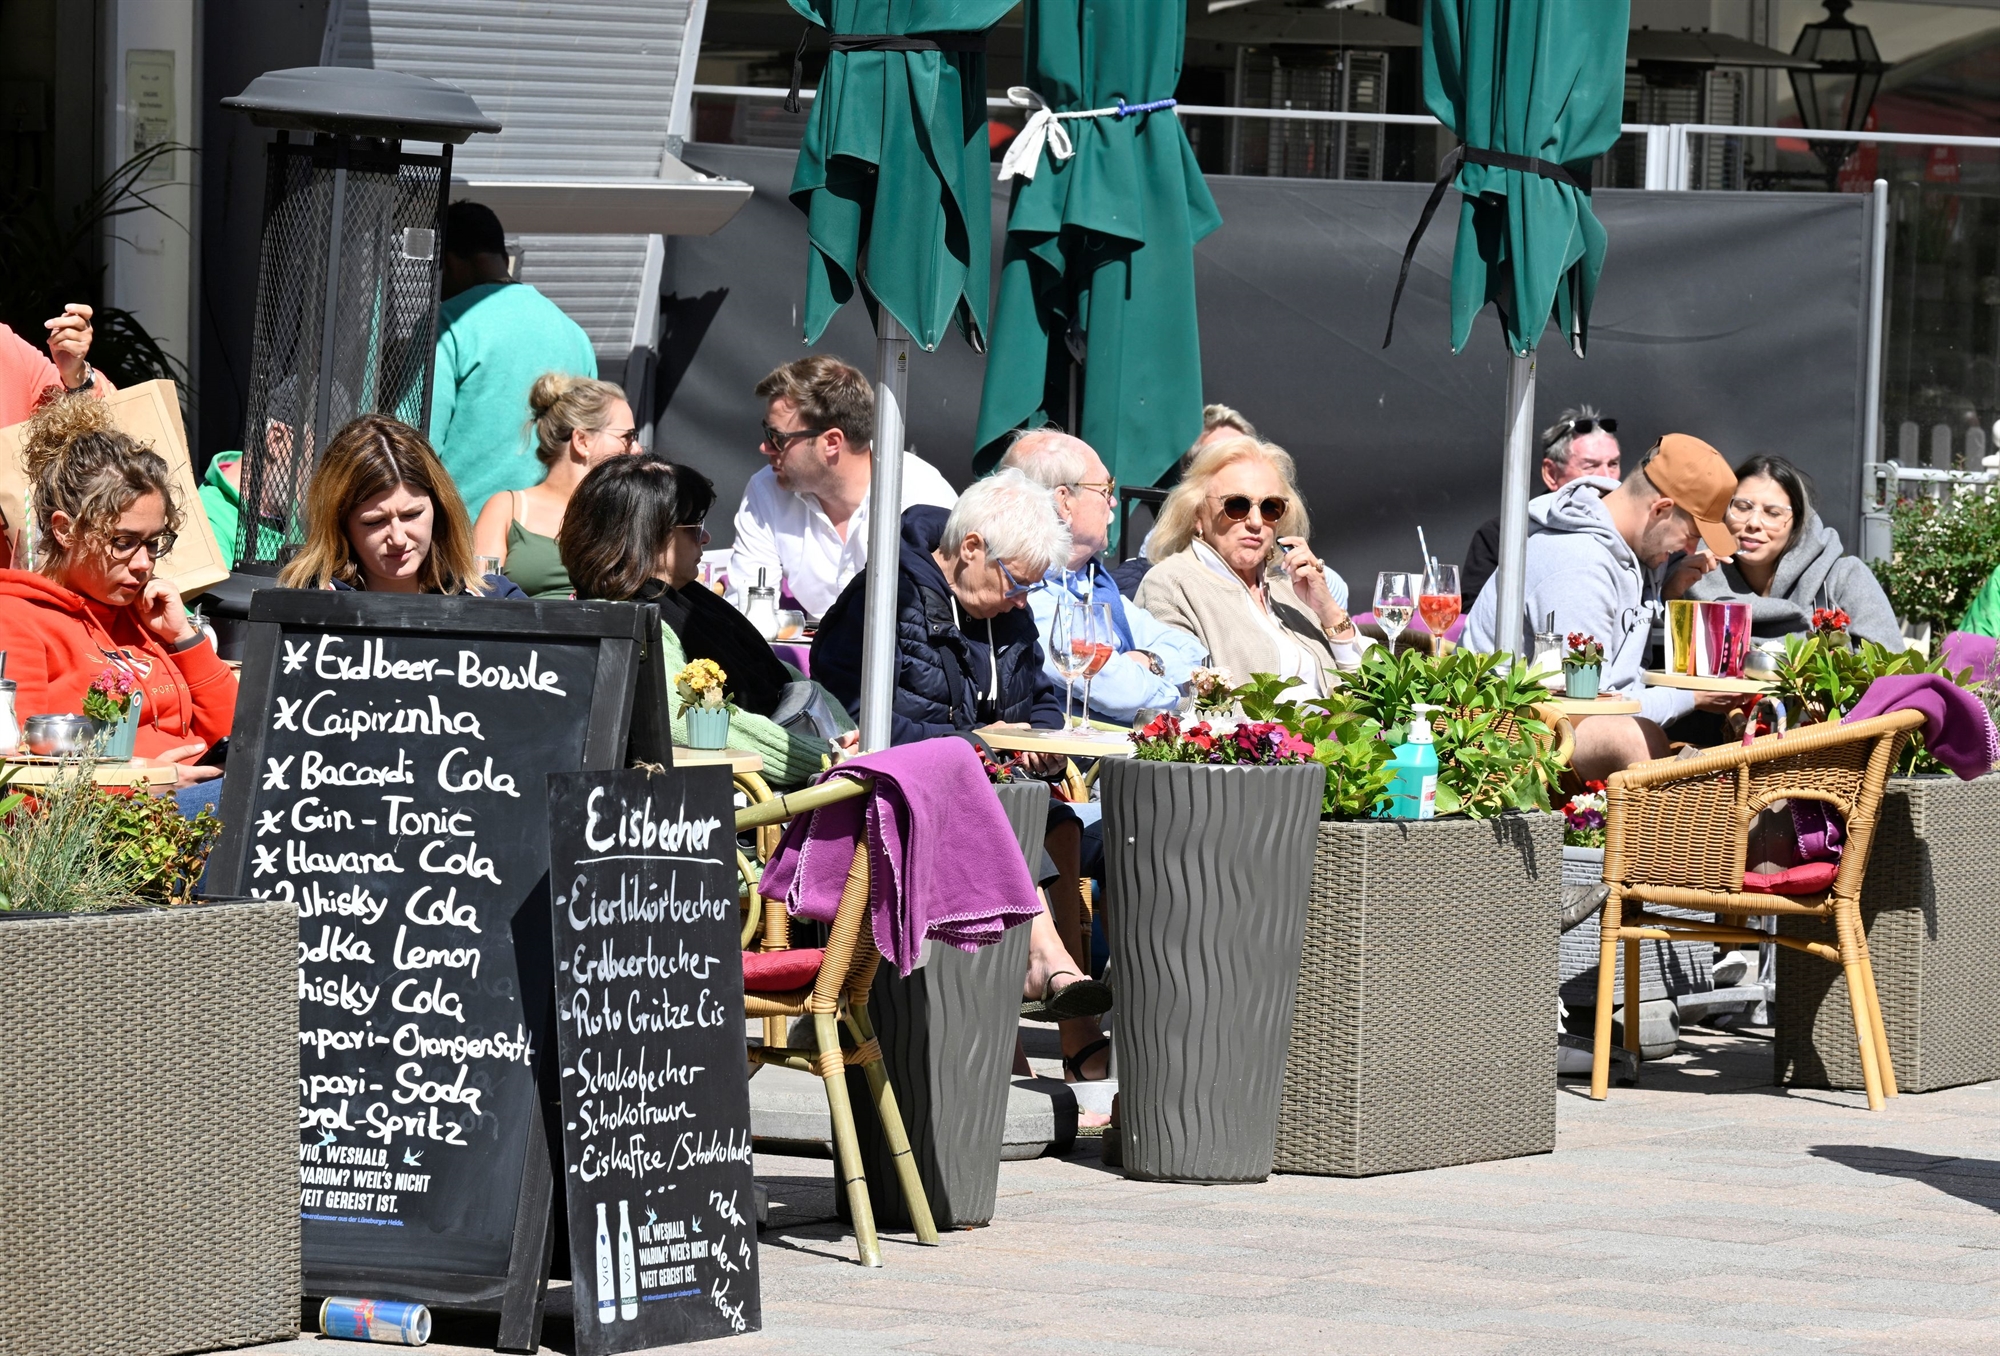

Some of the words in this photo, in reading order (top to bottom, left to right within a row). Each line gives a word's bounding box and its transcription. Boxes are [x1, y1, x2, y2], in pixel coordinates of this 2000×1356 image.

[302, 689, 485, 742] Caipirinha
[300, 748, 415, 790] Bacardi
[437, 747, 521, 798] Cola
[585, 786, 722, 853] Eisbecher
[286, 839, 405, 878] Havana
[418, 840, 502, 885] Cola
[405, 886, 483, 934] Cola
[299, 924, 376, 965] odka
[299, 967, 380, 1016] hisky
[391, 978, 466, 1023] Cola
[697, 988, 725, 1028] Eis
[325, 1190, 375, 1211] GEREIST
[376, 1194, 399, 1213] IST.
[394, 1173, 431, 1193] NICHT
